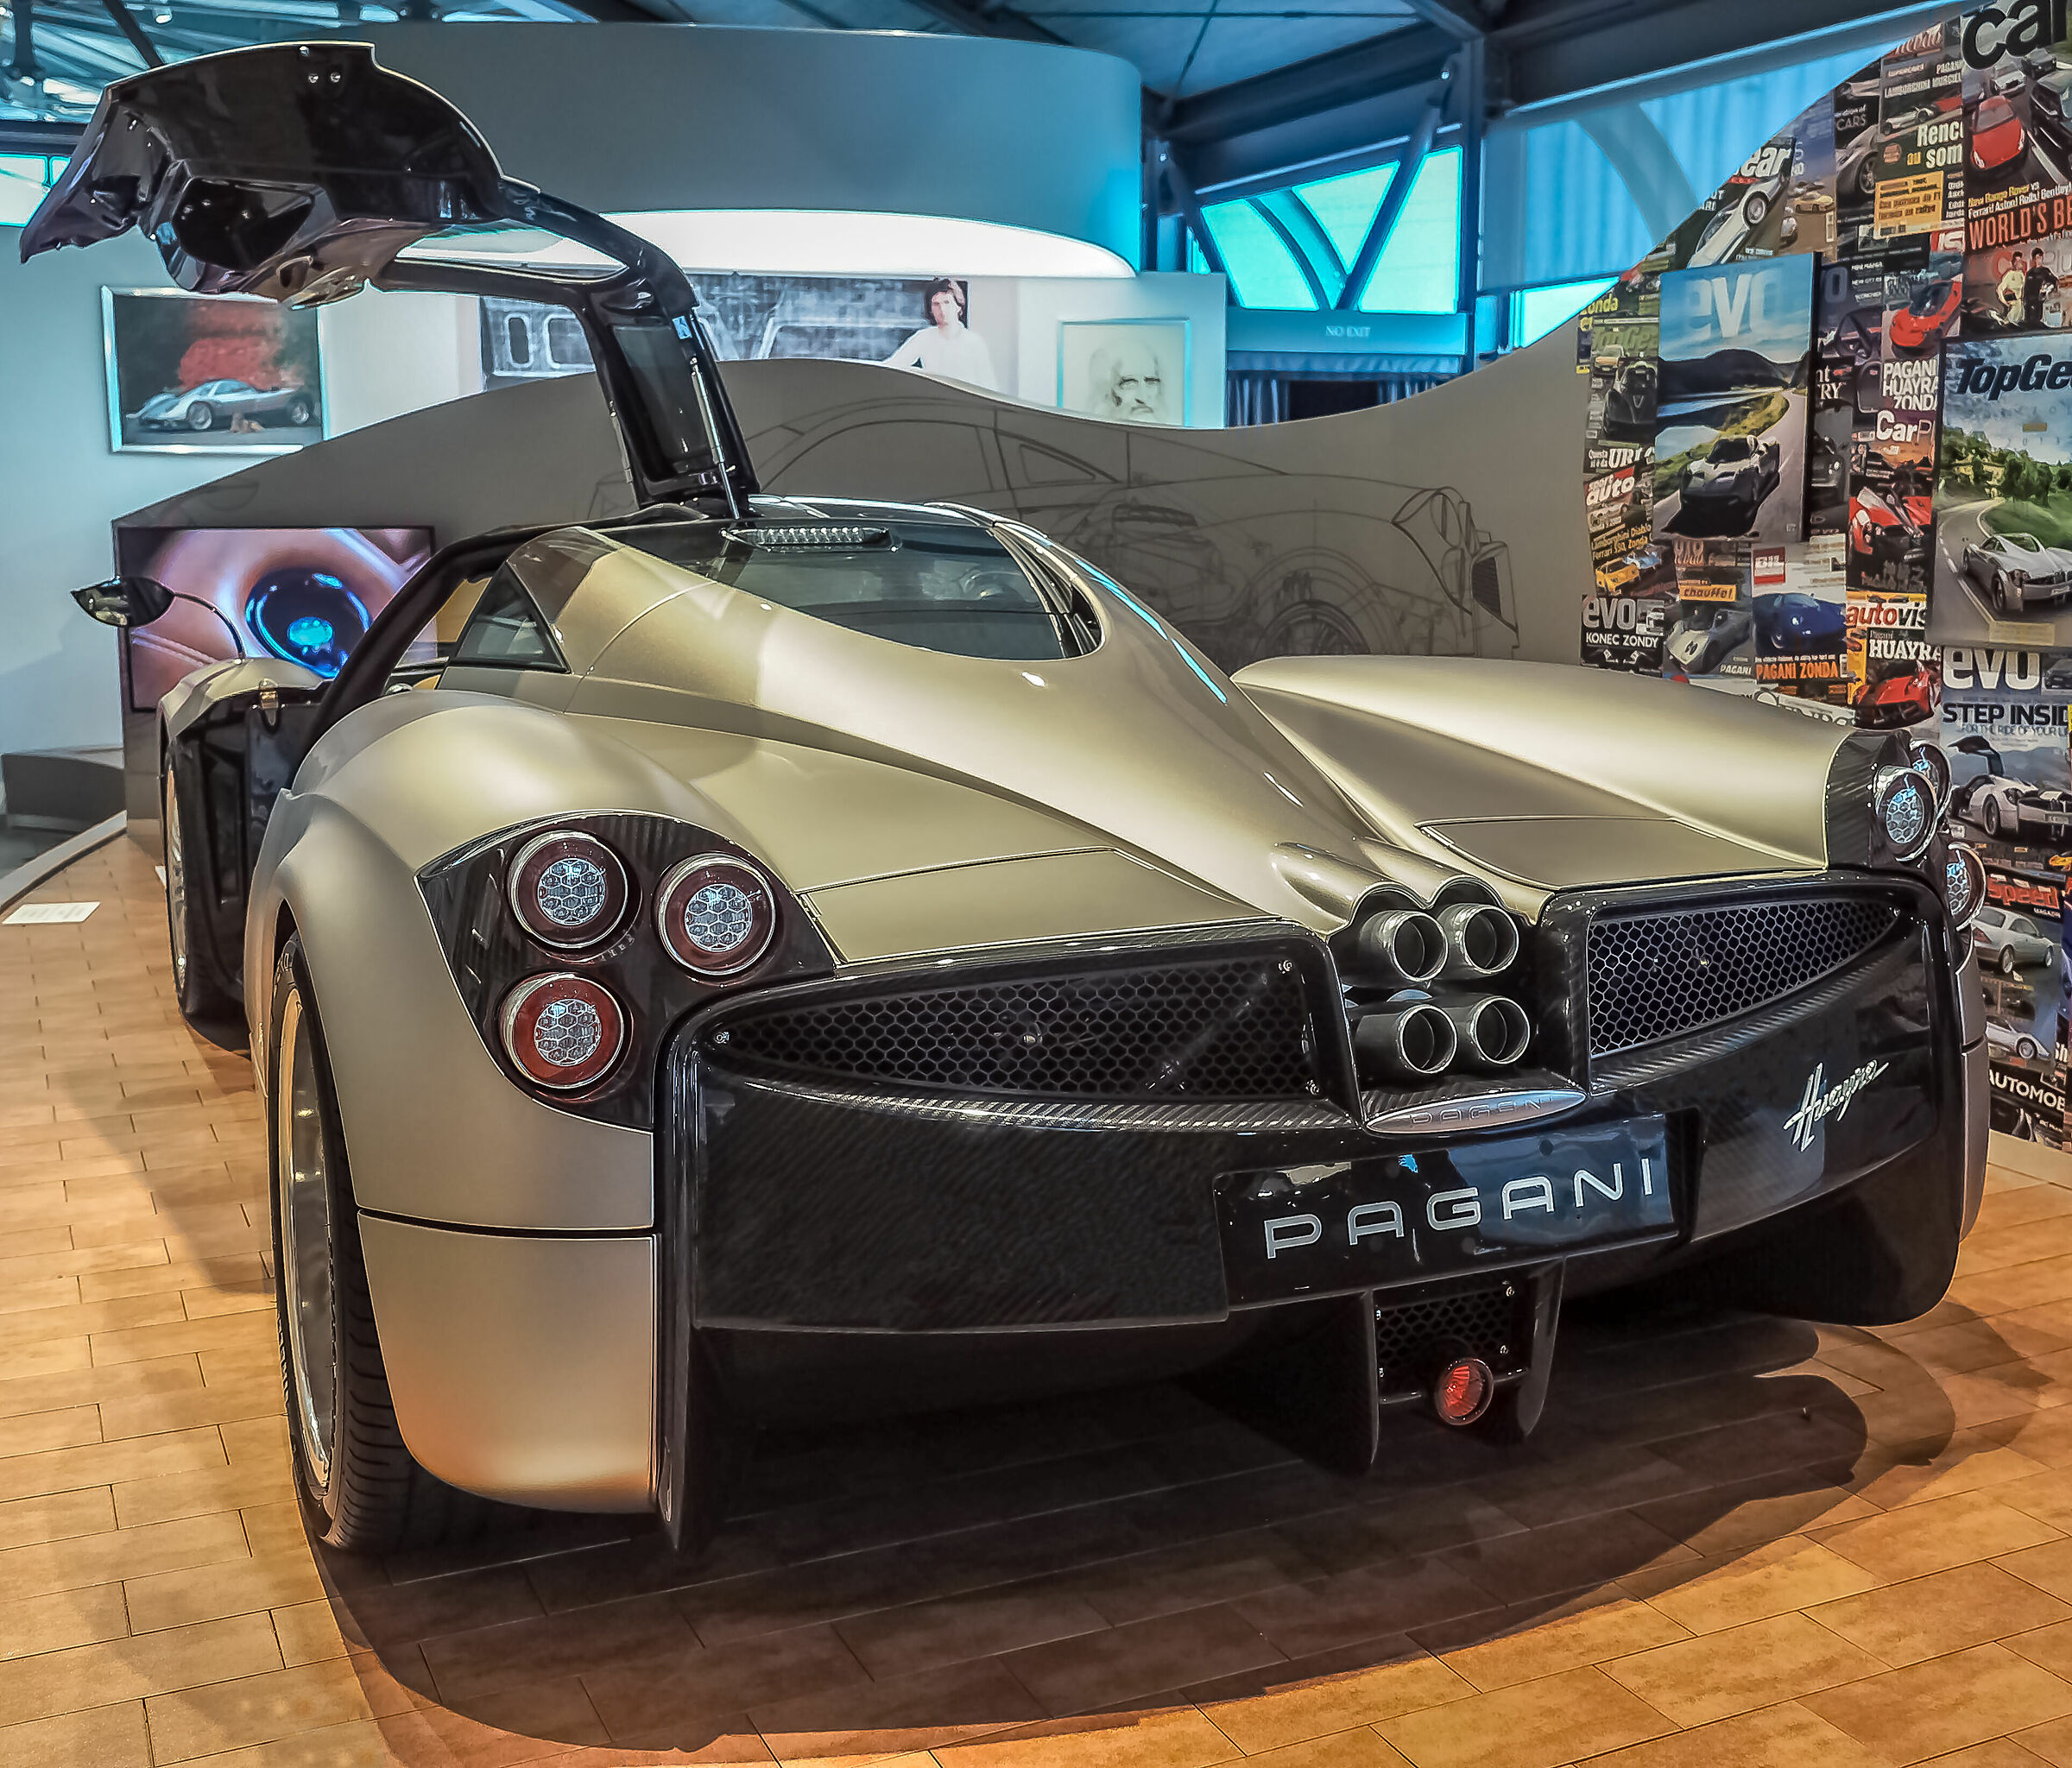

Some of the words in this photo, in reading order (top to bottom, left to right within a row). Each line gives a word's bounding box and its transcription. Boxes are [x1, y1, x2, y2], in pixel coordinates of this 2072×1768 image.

[1836, 114, 1867, 131] CARS
[1734, 147, 1791, 178] ear
[1969, 202, 2047, 250] WORLD'S
[1325, 325, 1344, 338] NO
[1346, 325, 1371, 338] EXIT
[1884, 359, 1938, 382] PAGANI
[1956, 353, 2072, 401] TopGe
[1586, 477, 1634, 506] auto
[1631, 523, 1652, 537] Diablo
[1582, 597, 1637, 630] evo
[1586, 632, 1620, 645] KONEC
[1622, 634, 1658, 647] ZONDY
[1869, 640, 1941, 661] HUAYRA
[1720, 663, 1752, 675] PAGANI
[1756, 663, 1796, 680] PAGANI
[1799, 660, 1839, 679] ZONDA
[1943, 647, 2041, 690] evo
[1942, 703, 2004, 723] STEP
[1987, 875, 2059, 909] Speed
[1409, 1096, 1555, 1125] PAGANI
[1264, 1158, 1653, 1260] PAGANI
